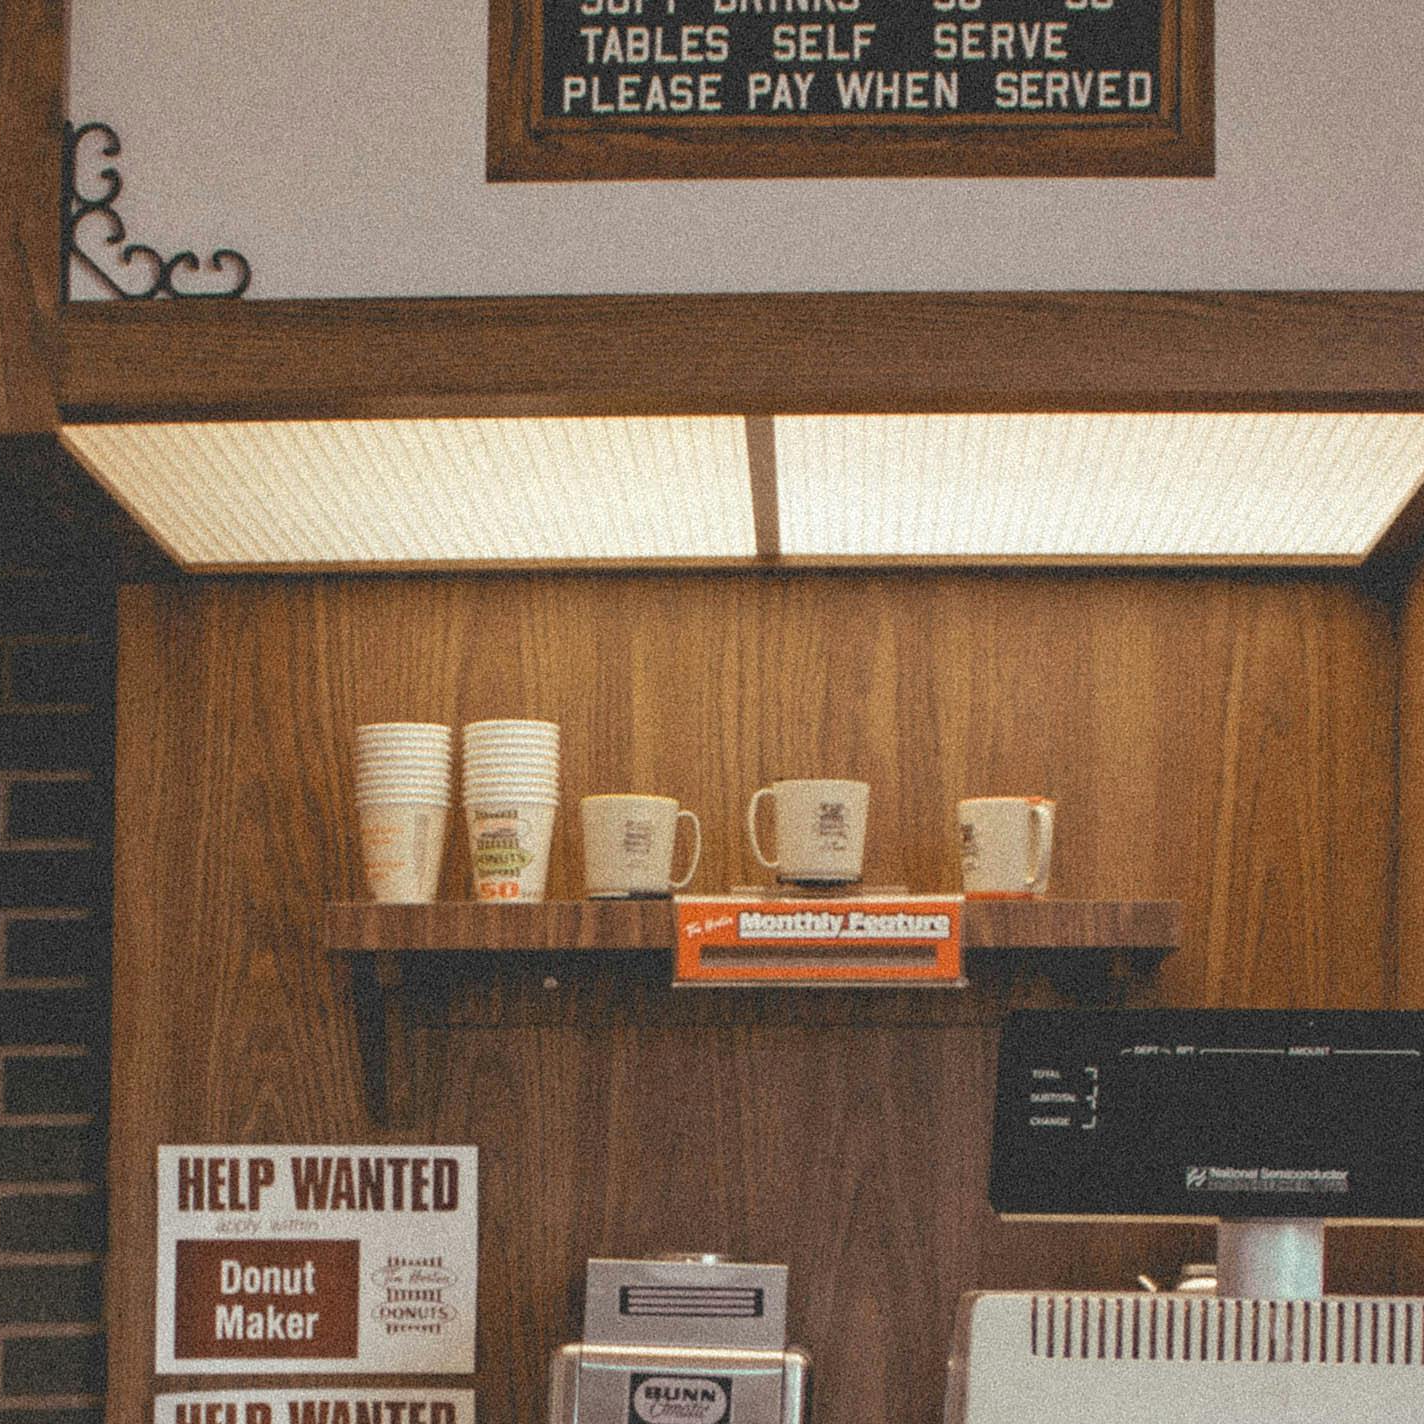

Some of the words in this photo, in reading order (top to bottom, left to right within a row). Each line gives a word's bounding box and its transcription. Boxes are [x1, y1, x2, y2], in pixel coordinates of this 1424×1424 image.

[581, 25, 730, 64] TABLES
[773, 23, 876, 62] SELF
[933, 22, 1068, 60] SERVE
[562, 74, 722, 113] PLEASE
[748, 72, 815, 110] PAY
[836, 71, 959, 109] WHEN
[995, 70, 1153, 108] SERVED
[739, 911, 844, 936] Monthly
[847, 911, 950, 932] Feature
[1288, 1045, 1332, 1056] AMOUNT
[178, 1157, 275, 1212] HELP
[291, 1156, 459, 1212] WANTED
[1209, 1168, 1259, 1180] National
[220, 1259, 316, 1295] Donut
[215, 1304, 320, 1341] Maker
[379, 1306, 449, 1322] DONUTS
[644, 1386, 716, 1402] BUNN
